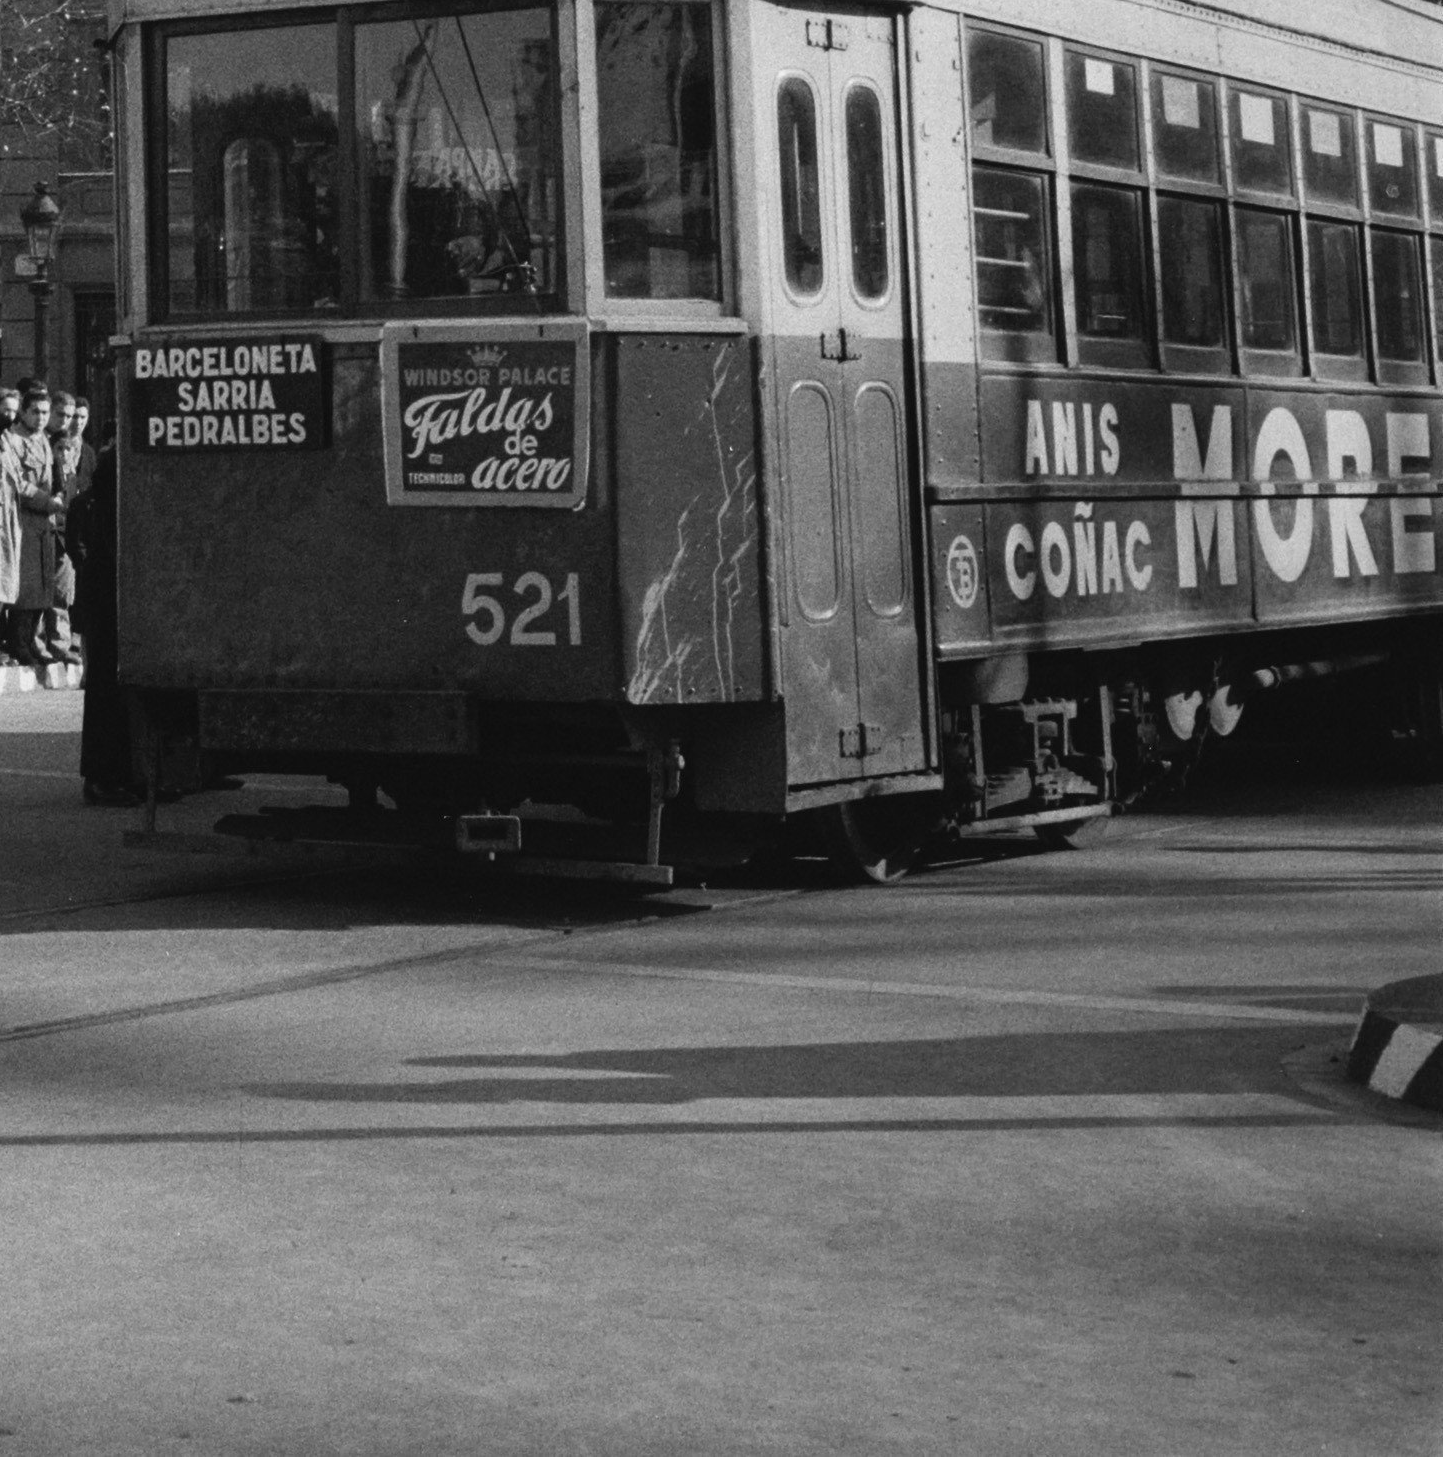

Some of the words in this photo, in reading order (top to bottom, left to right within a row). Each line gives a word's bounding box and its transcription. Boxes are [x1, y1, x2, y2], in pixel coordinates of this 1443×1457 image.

[135, 343, 317, 379] BARCELONETA
[403, 368, 491, 387] WINDSOR
[498, 367, 571, 386] PALACE
[177, 379, 276, 412] SARRIA
[148, 412, 306, 446] PEDRALBES
[404, 387, 553, 459] Faldas
[1026, 400, 1121, 476] ANIS
[504, 429, 539, 456] de
[471, 456, 571, 491] acero
[1171, 403, 1443, 588] MORE
[1005, 501, 1153, 600] COÑAC
[461, 571, 582, 646] 521
